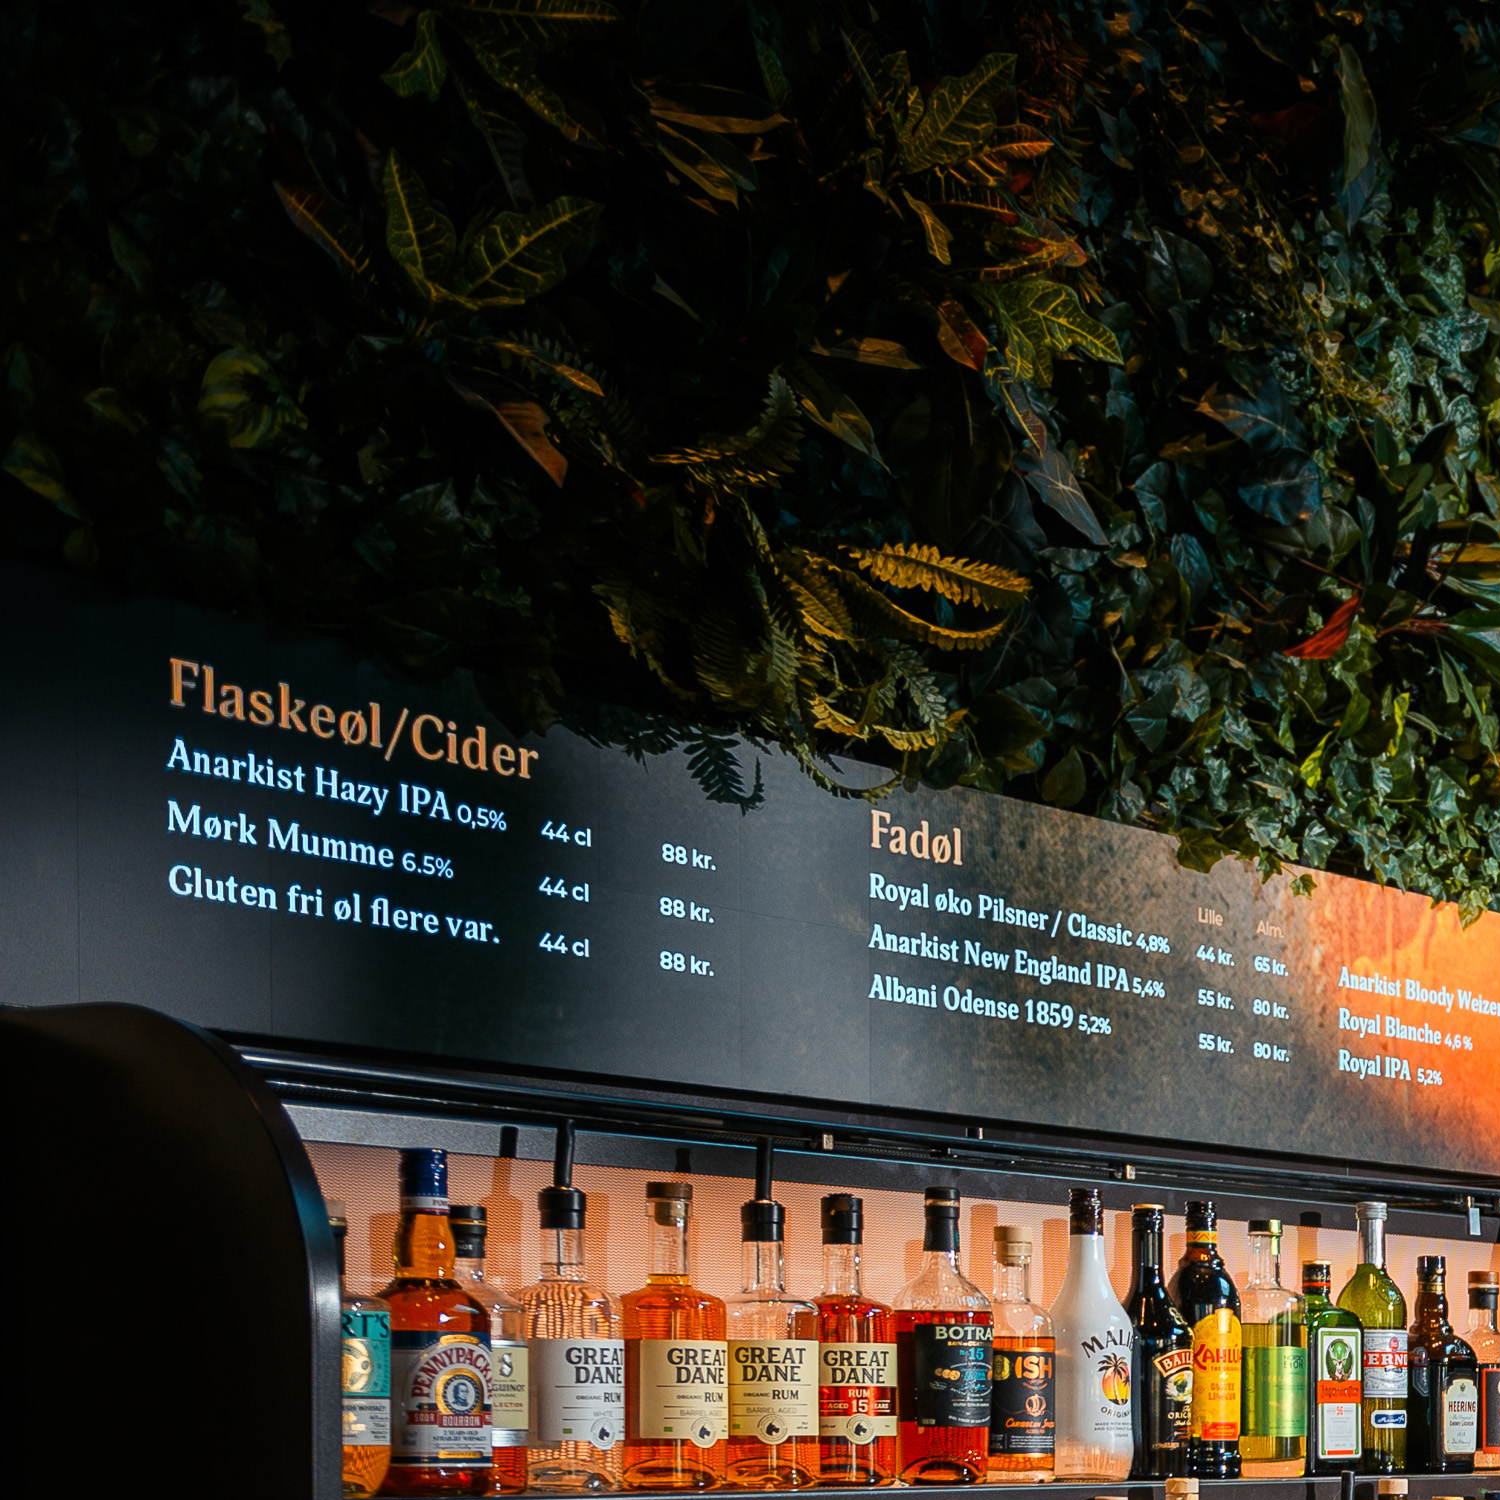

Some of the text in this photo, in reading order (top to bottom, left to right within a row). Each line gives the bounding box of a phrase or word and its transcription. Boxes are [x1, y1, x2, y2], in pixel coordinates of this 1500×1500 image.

[169, 657, 538, 778] Flaskeøl/Cider
[167, 739, 507, 831] Anarkist Hazy IPA 0,5%
[168, 800, 454, 879] Mørk Mumme 6.5%
[541, 822, 592, 847] 44 cl
[871, 809, 962, 865] Fadøl
[662, 844, 716, 871] 88 kr.
[539, 877, 589, 902] 44 cl
[169, 864, 500, 944] Gluten fri øl flere var.
[660, 898, 714, 924] 88 kr.
[869, 873, 1170, 954] Royal øko Pilsner / Classic 4,8%
[1198, 907, 1284, 939] Lille Alm.
[539, 933, 589, 958] 44 cl
[1197, 944, 1235, 967] 44 kr.
[660, 952, 714, 977] 88 kr.
[869, 924, 1165, 998] Anarkist New England IPA 5,4%
[1255, 955, 1289, 977] 65 kr.
[1198, 989, 1234, 1010] 55 kr.
[1339, 966, 1401, 998] Anarkist
[1406, 979, 1453, 1012] Bloody
[869, 974, 1111, 1035] Albani Odense 1859 5,2%
[1253, 999, 1289, 1020] 80 kr.
[1339, 1007, 1380, 1038] Royal
[1385, 1015, 1441, 1045] Blanche
[1199, 1033, 1234, 1054] 55 kr.
[1253, 1041, 1289, 1062] 80 kr.
[1339, 1049, 1442, 1085] Royal IPA 5,2%
[565, 1346, 624, 1366] GREAT
[667, 1347, 726, 1366] GREAT
[734, 1346, 806, 1364] GREAT
[823, 1350, 889, 1367] GREAT
[969, 1347, 984, 1360] 15
[574, 1366, 622, 1384] DANE
[675, 1366, 724, 1384] DANE
[742, 1365, 801, 1382] DANE
[831, 1368, 885, 1384] DANE
[1015, 1355, 1052, 1379] ISH
[603, 1392, 622, 1403] RUM
[704, 1392, 723, 1403] RUM
[772, 1389, 799, 1400] RUM
[848, 1388, 871, 1398] RUM
[679, 1409, 707, 1417] BARREL
[828, 1402, 849, 1410] AGED
[851, 1399, 869, 1413] 15
[1448, 1401, 1476, 1413] HEERING
[414, 1413, 482, 1427] SOUR BOURBON
